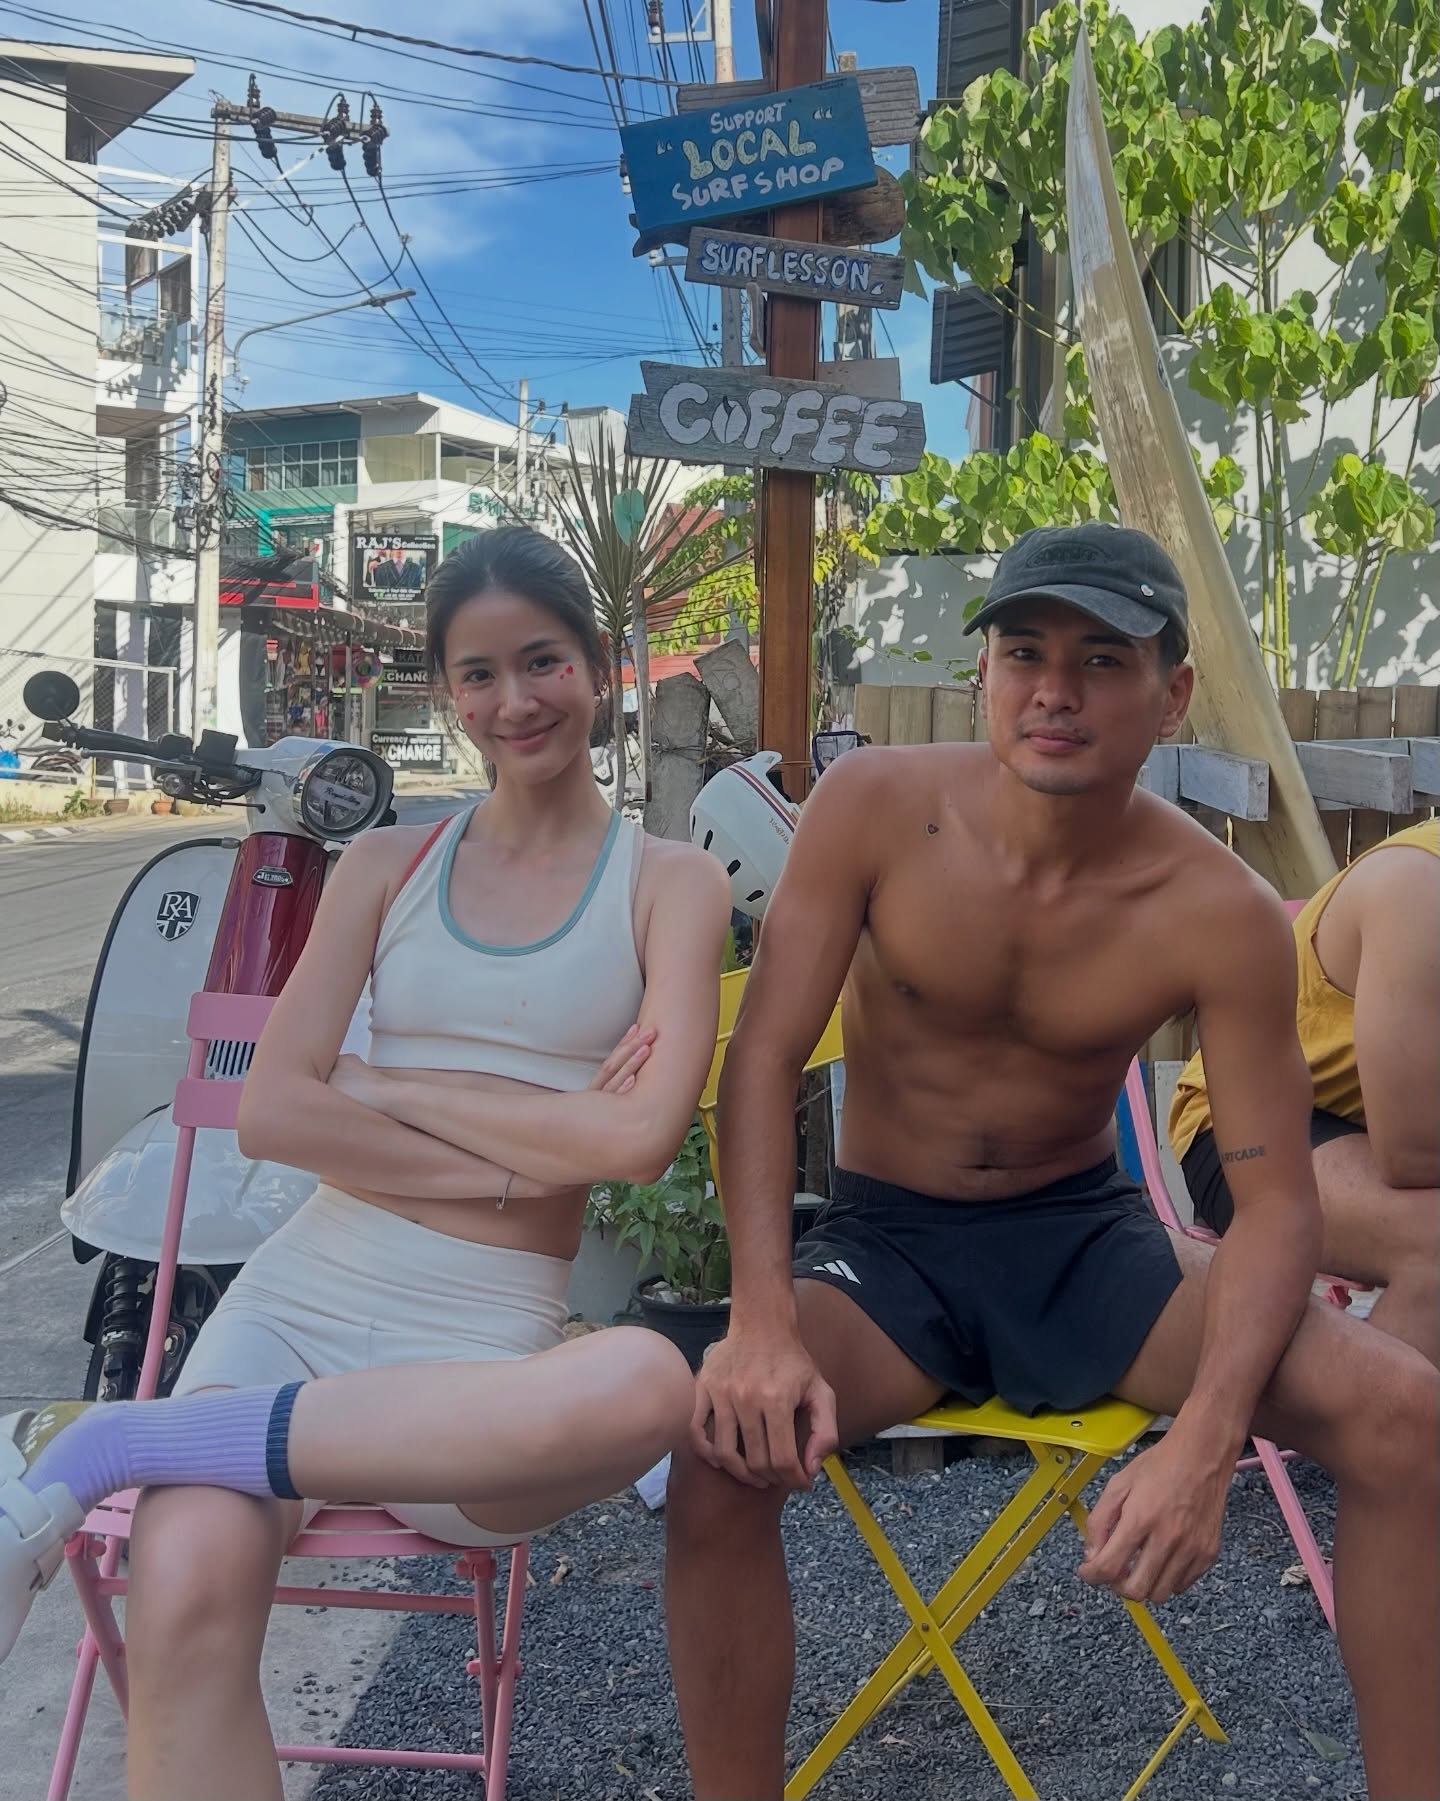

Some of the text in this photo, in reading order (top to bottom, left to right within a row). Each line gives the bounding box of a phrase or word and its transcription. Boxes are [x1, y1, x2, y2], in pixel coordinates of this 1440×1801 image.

[710, 102, 787, 135] SUPPORT
[682, 120, 817, 181] LOCAL
[672, 156, 844, 210] SURF SHOP
[658, 381, 908, 468] COFFEE
[355, 535, 402, 549] RAJ'S
[372, 733, 408, 744] Currency
